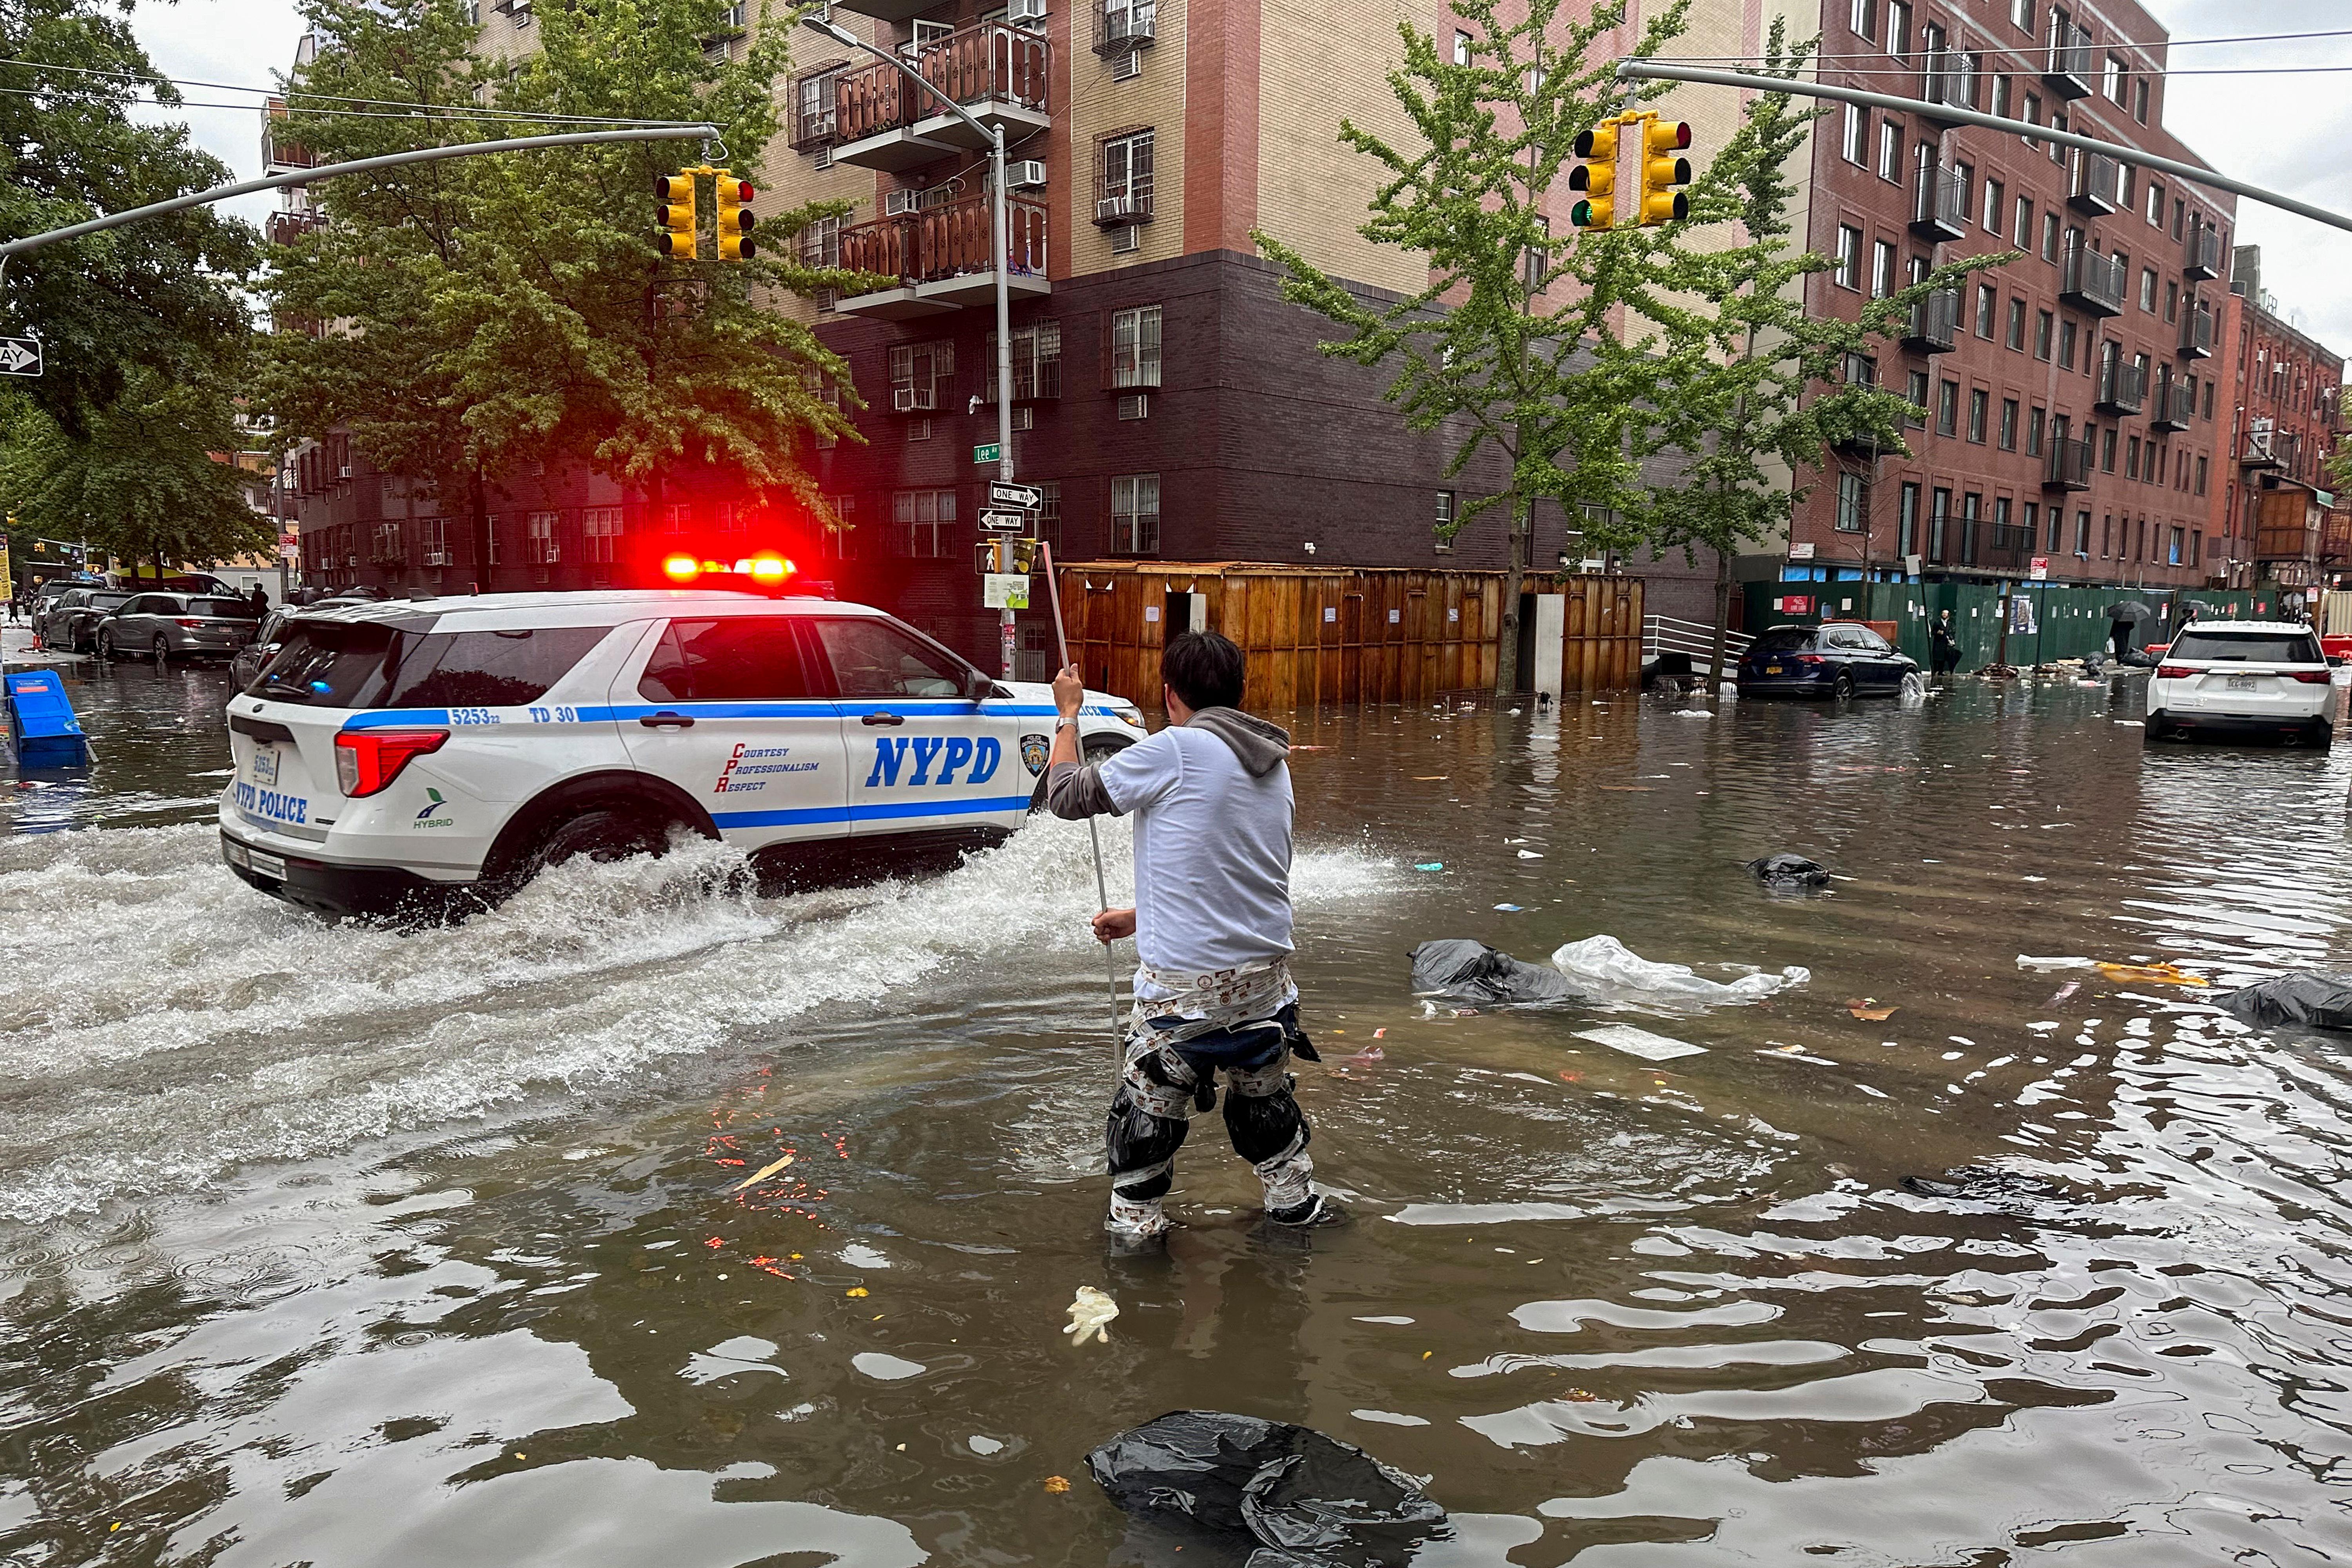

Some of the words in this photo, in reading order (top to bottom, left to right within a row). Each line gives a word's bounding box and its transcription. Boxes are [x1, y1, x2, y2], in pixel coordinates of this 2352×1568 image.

[0, 349, 24, 363] AY
[977, 448, 989, 460] Lee
[996, 489, 1013, 499] ONE
[1019, 493, 1034, 502] WAY
[987, 516, 999, 524] ONE
[1005, 517, 1018, 525] WAY
[528, 707, 550, 723] TD
[555, 707, 574, 722] 30
[1022, 740, 1048, 748] DEPARTMENT
[864, 737, 1001, 787] NYPD
[258, 789, 307, 824] POLICE
[413, 818, 454, 829] HYBRID
